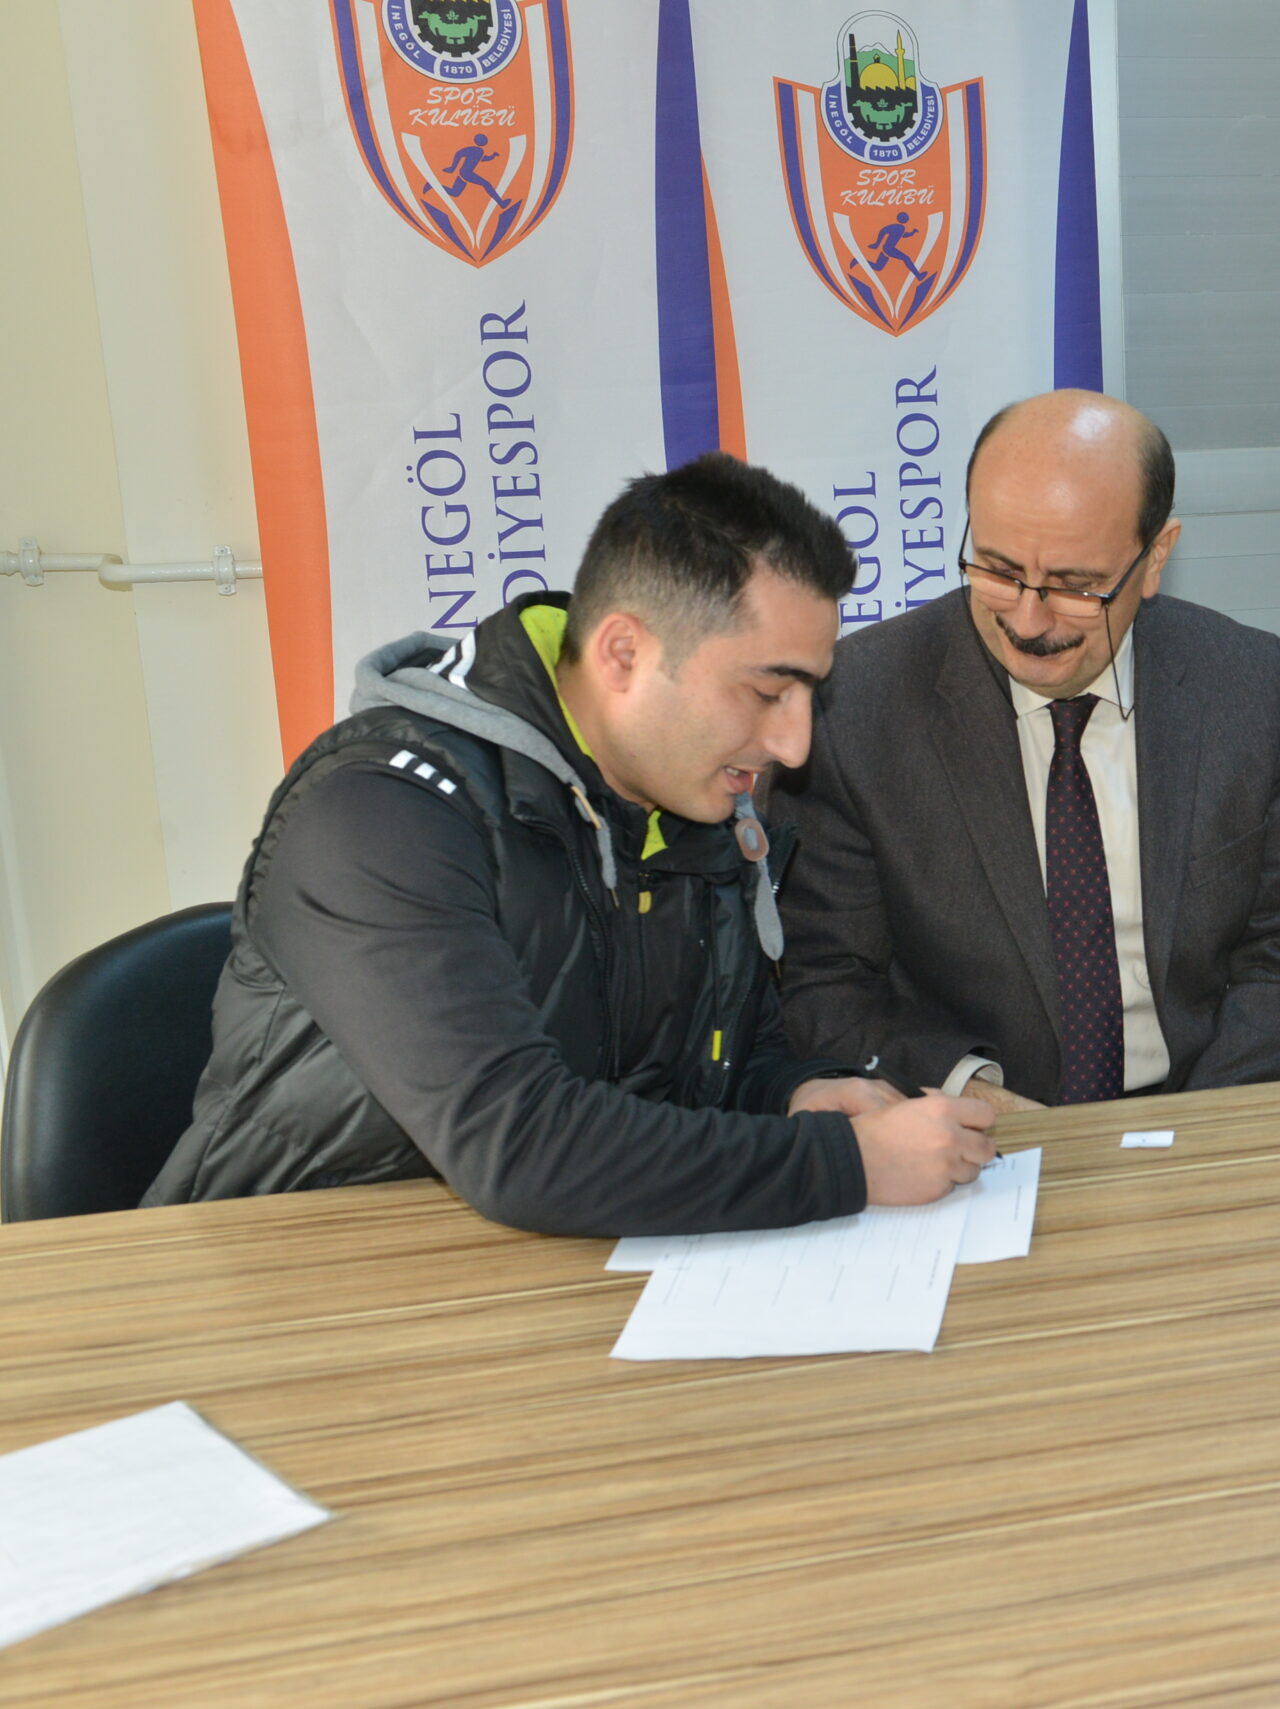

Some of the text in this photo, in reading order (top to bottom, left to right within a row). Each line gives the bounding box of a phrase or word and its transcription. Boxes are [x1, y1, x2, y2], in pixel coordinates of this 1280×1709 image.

[443, 65, 473, 74] 1870
[426, 86, 494, 105] SPOR
[408, 105, 516, 127] KULÜBÜ
[872, 149, 899, 158] 1870
[856, 168, 917, 186] SPOR
[840, 185, 934, 207] KULÜBÜ
[480, 299, 549, 608] DİYESPOR
[406, 412, 479, 630] NEGÖL
